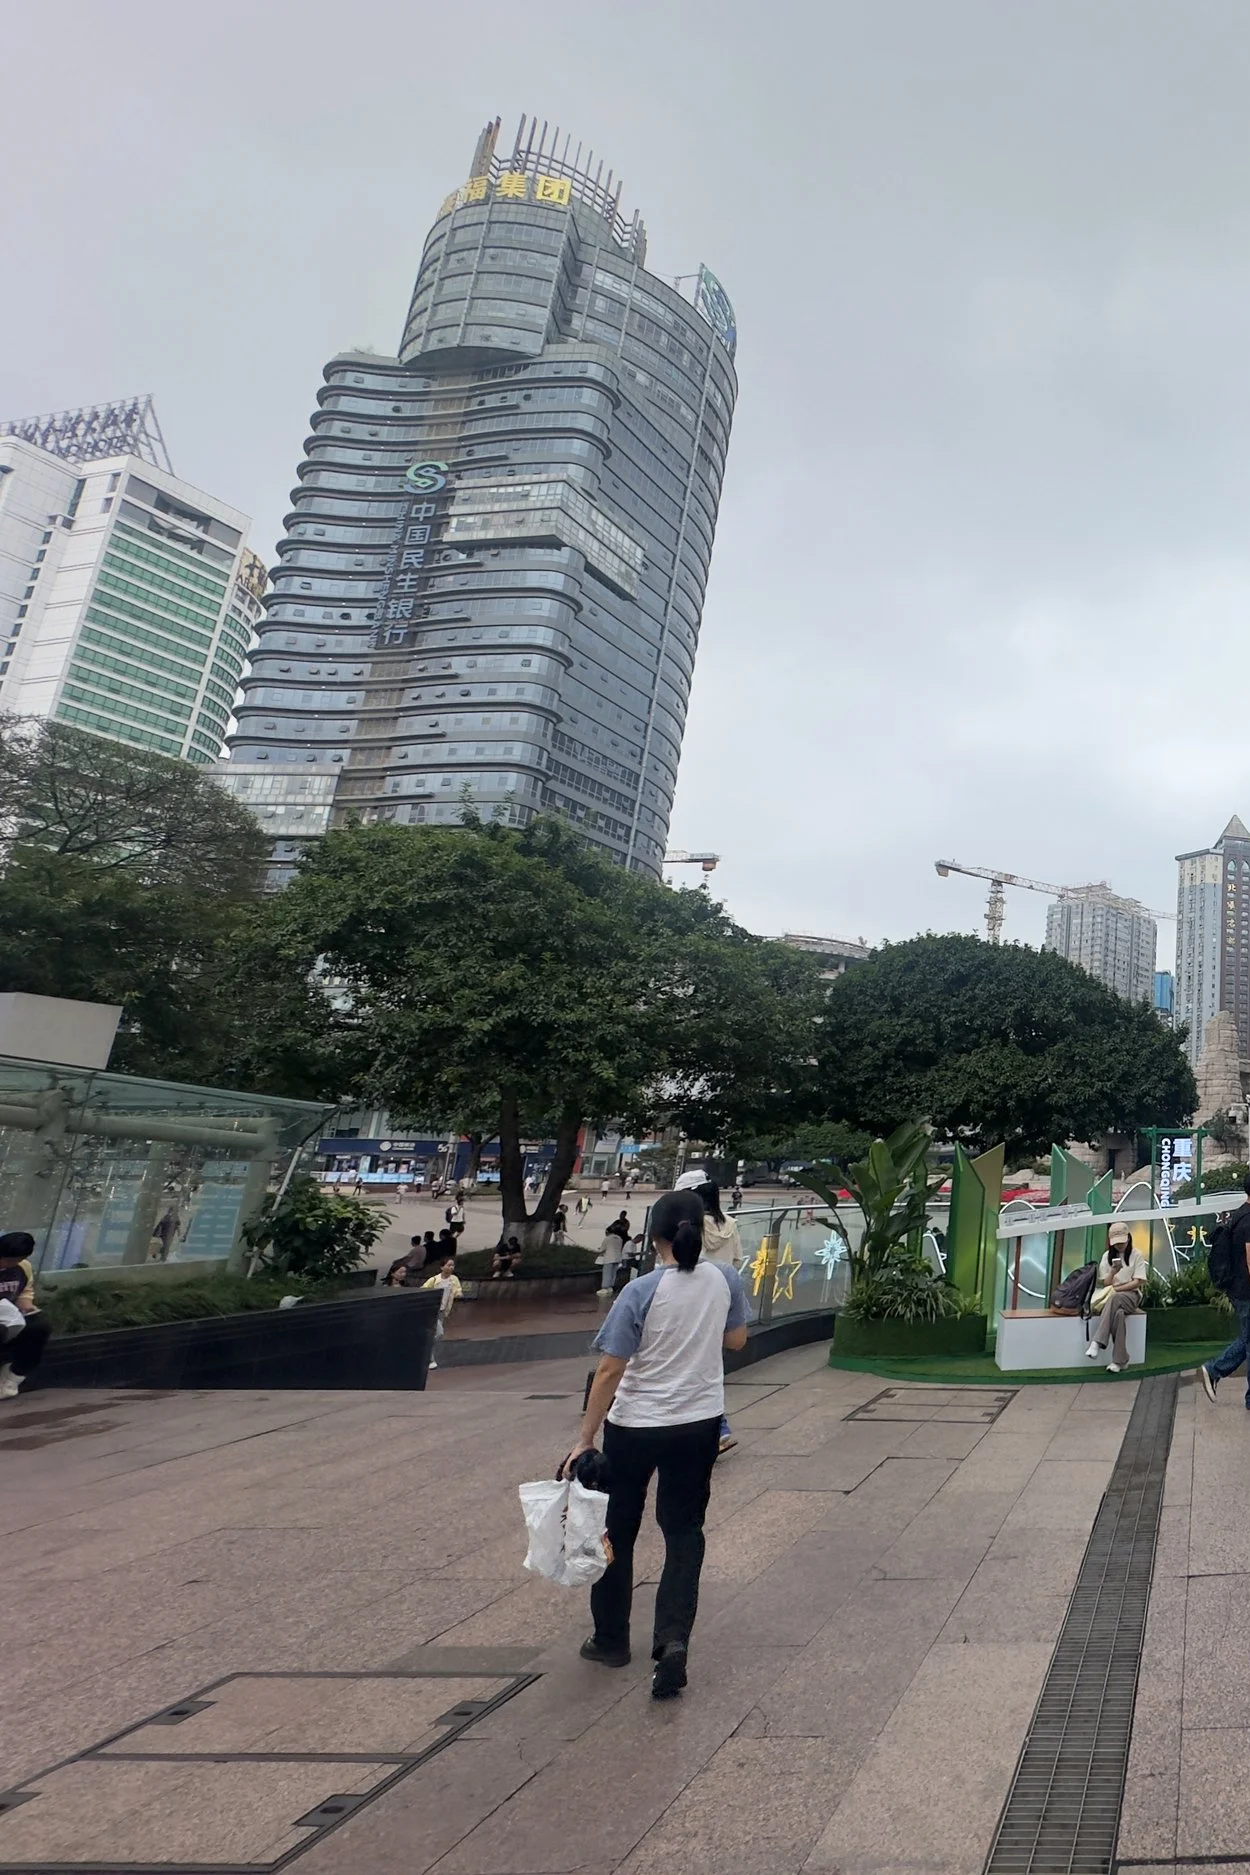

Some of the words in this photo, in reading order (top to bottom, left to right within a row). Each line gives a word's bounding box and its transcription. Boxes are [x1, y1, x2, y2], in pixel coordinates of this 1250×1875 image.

[382, 502, 436, 646] 中国民生银行
[1160, 1137, 1172, 1208] CHONGQING
[1173, 1138, 1193, 1182] 重庆
